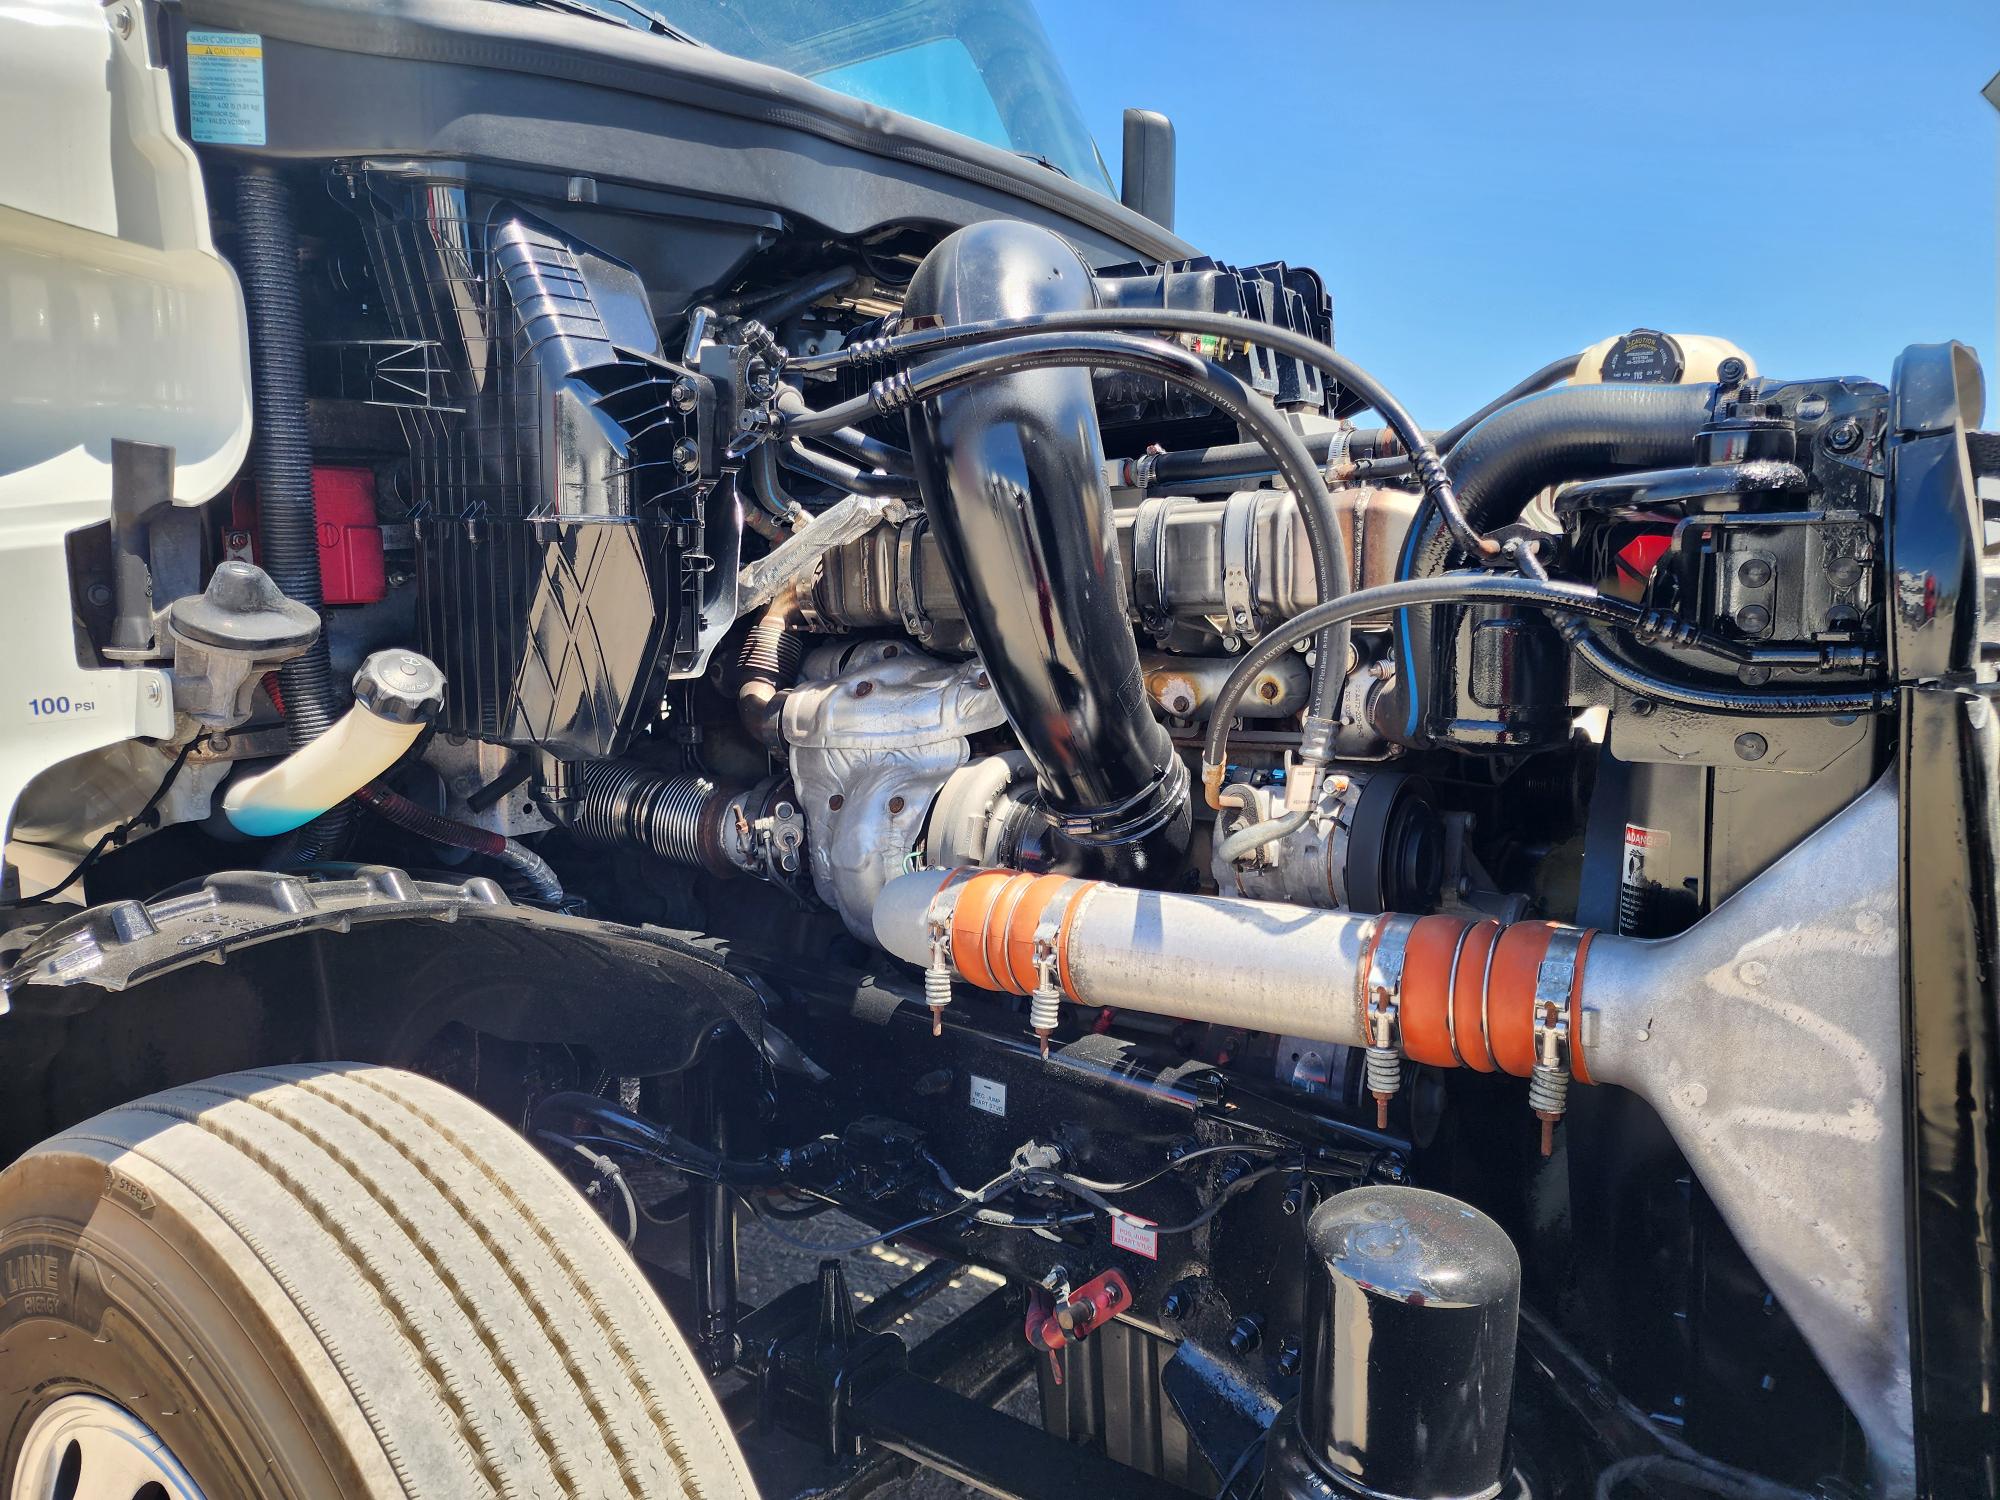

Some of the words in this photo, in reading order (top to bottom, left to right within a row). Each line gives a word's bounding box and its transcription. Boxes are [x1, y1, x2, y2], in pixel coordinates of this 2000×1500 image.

[211, 35, 258, 45] CONDITIONER
[213, 47, 246, 56] CAUTION
[1631, 337, 1656, 346] CAUTION
[1079, 356, 1106, 364] SUCTION
[1207, 389, 1238, 413] GALAXY
[1320, 567, 1328, 592] SUCTION
[29, 696, 70, 716] 100
[75, 701, 95, 712] PSI
[971, 1097, 988, 1107] START
[119, 1177, 148, 1203] STEER
[4, 1254, 59, 1293] LINE
[24, 1295, 60, 1315] ENERGY
